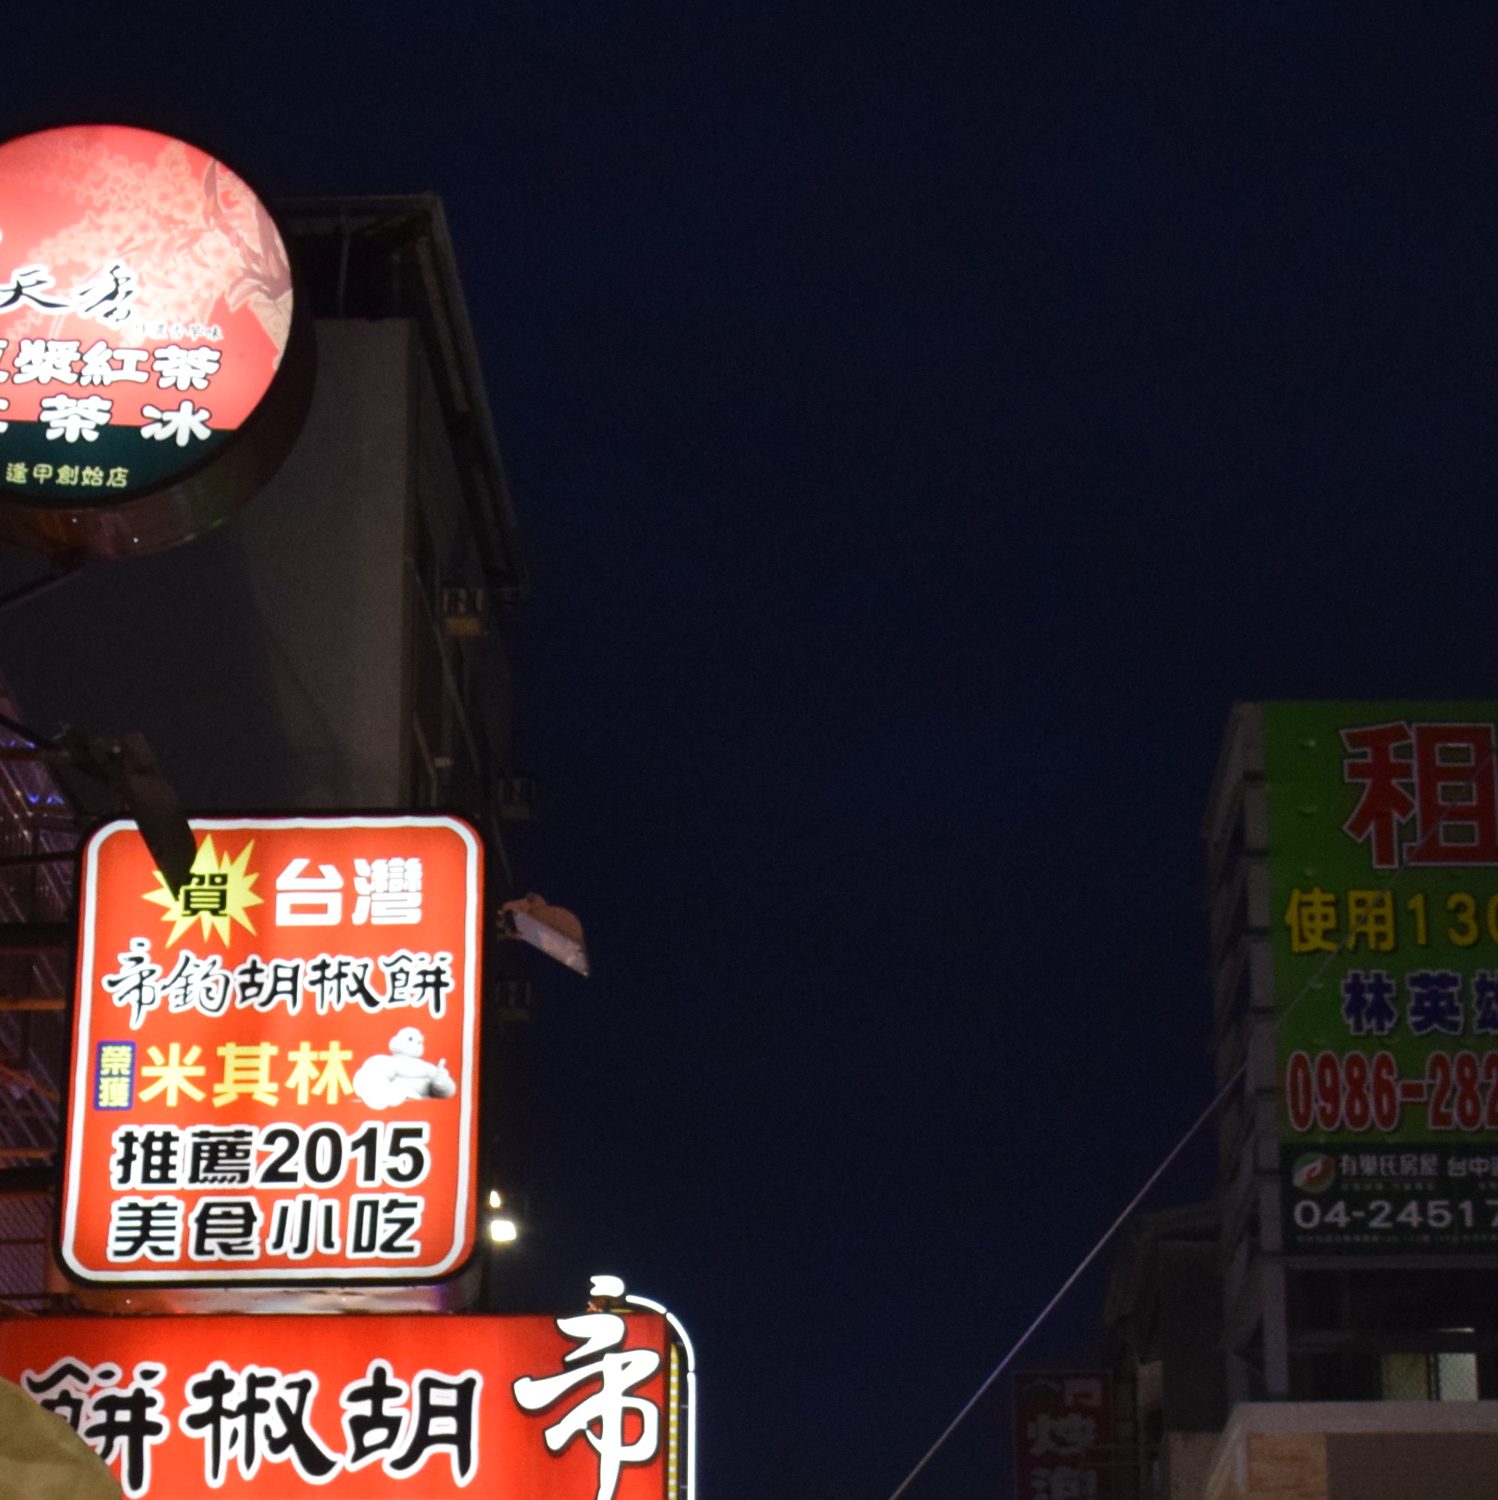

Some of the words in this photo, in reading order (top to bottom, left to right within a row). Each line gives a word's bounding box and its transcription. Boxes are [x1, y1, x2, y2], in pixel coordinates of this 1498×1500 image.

[6, 462, 128, 488] 逢甲創始店
[181, 873, 229, 917] 賀
[275, 857, 422, 926] 台灣
[99, 1045, 133, 1108] 榮獲
[139, 1041, 354, 1107] 米其林
[113, 1125, 429, 1188] 推薦2015
[108, 1196, 426, 1262] 美食小吃
